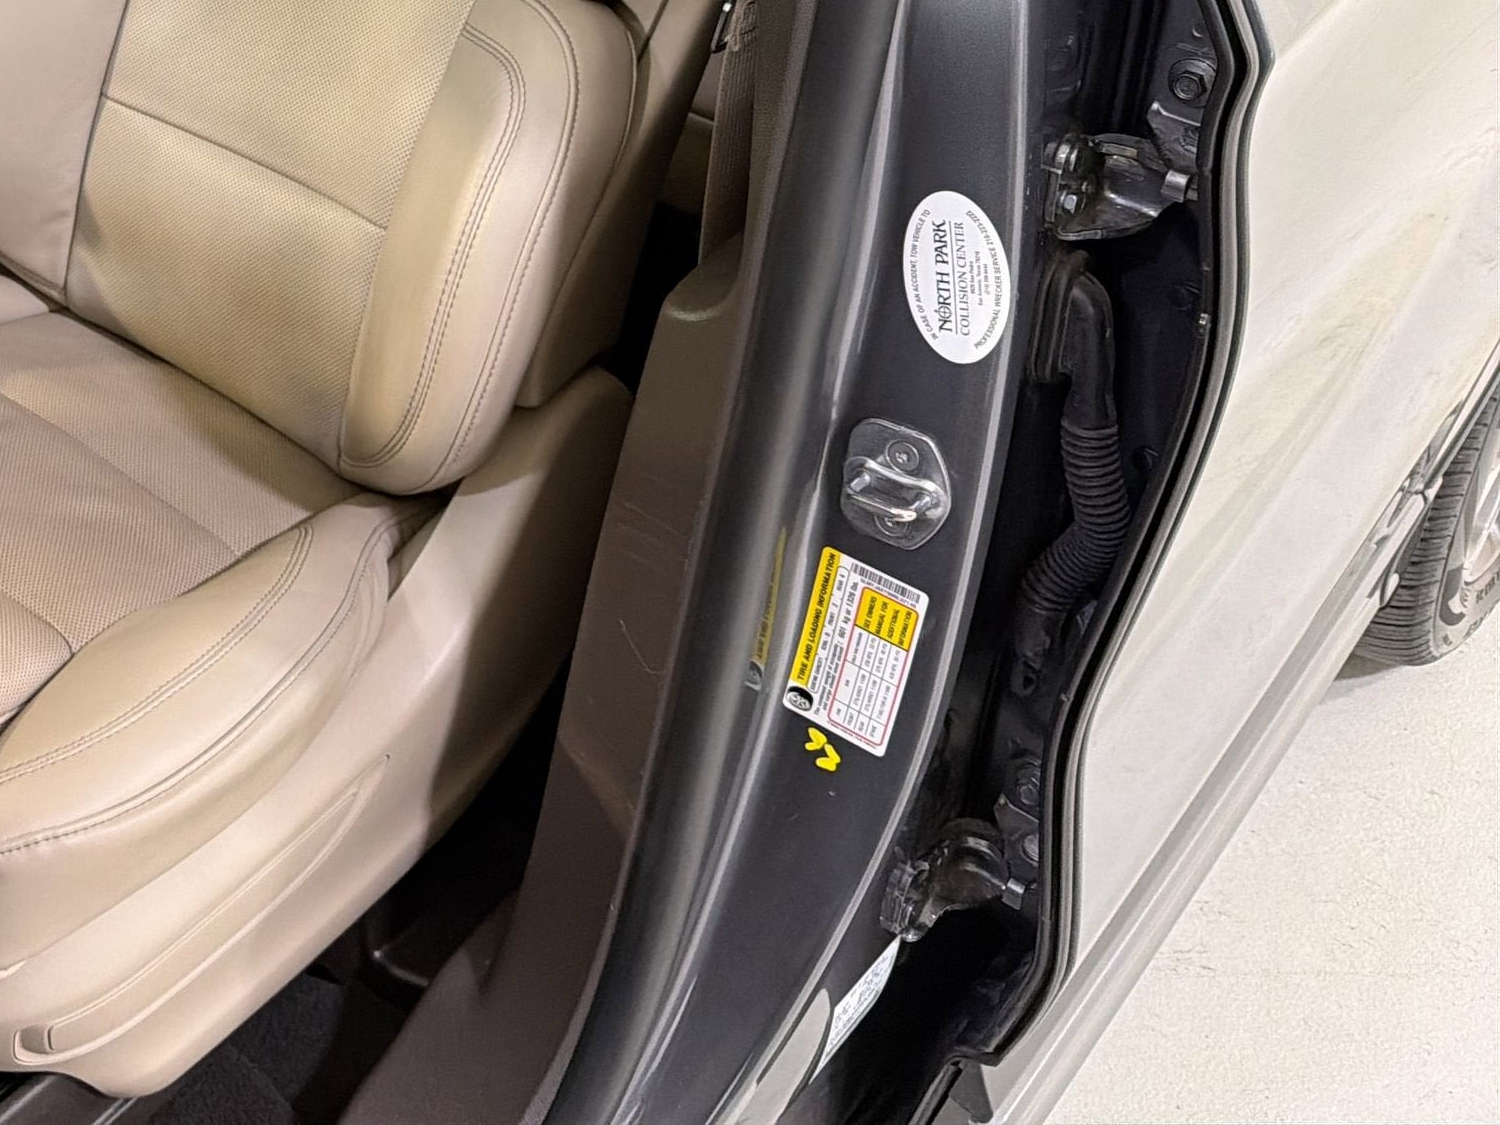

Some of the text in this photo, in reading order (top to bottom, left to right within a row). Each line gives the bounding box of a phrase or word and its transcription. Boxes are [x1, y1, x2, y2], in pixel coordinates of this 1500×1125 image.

[920, 209, 931, 218] TO
[912, 216, 926, 242] VEHICLE
[910, 243, 918, 257] TOW
[988, 247, 1001, 275] SERVICE
[931, 219, 953, 333] NORTH PARK
[953, 222, 971, 336] COLLISION CENTER
[914, 293, 922, 303] AN
[994, 276, 1002, 307] WRECKER
[916, 304, 925, 313] OF
[920, 315, 933, 332] CASE
[973, 309, 1001, 349] PROFESSIONAL
[797, 552, 836, 680] TIRE AND LOADING INFORMATION
[841, 616, 851, 624] kg
[863, 618, 871, 629] SEE
[875, 613, 886, 635] MANUAL
[881, 601, 889, 612] FOR
[887, 608, 900, 639] ADDITIONAL
[898, 610, 912, 646] INFORMATION
